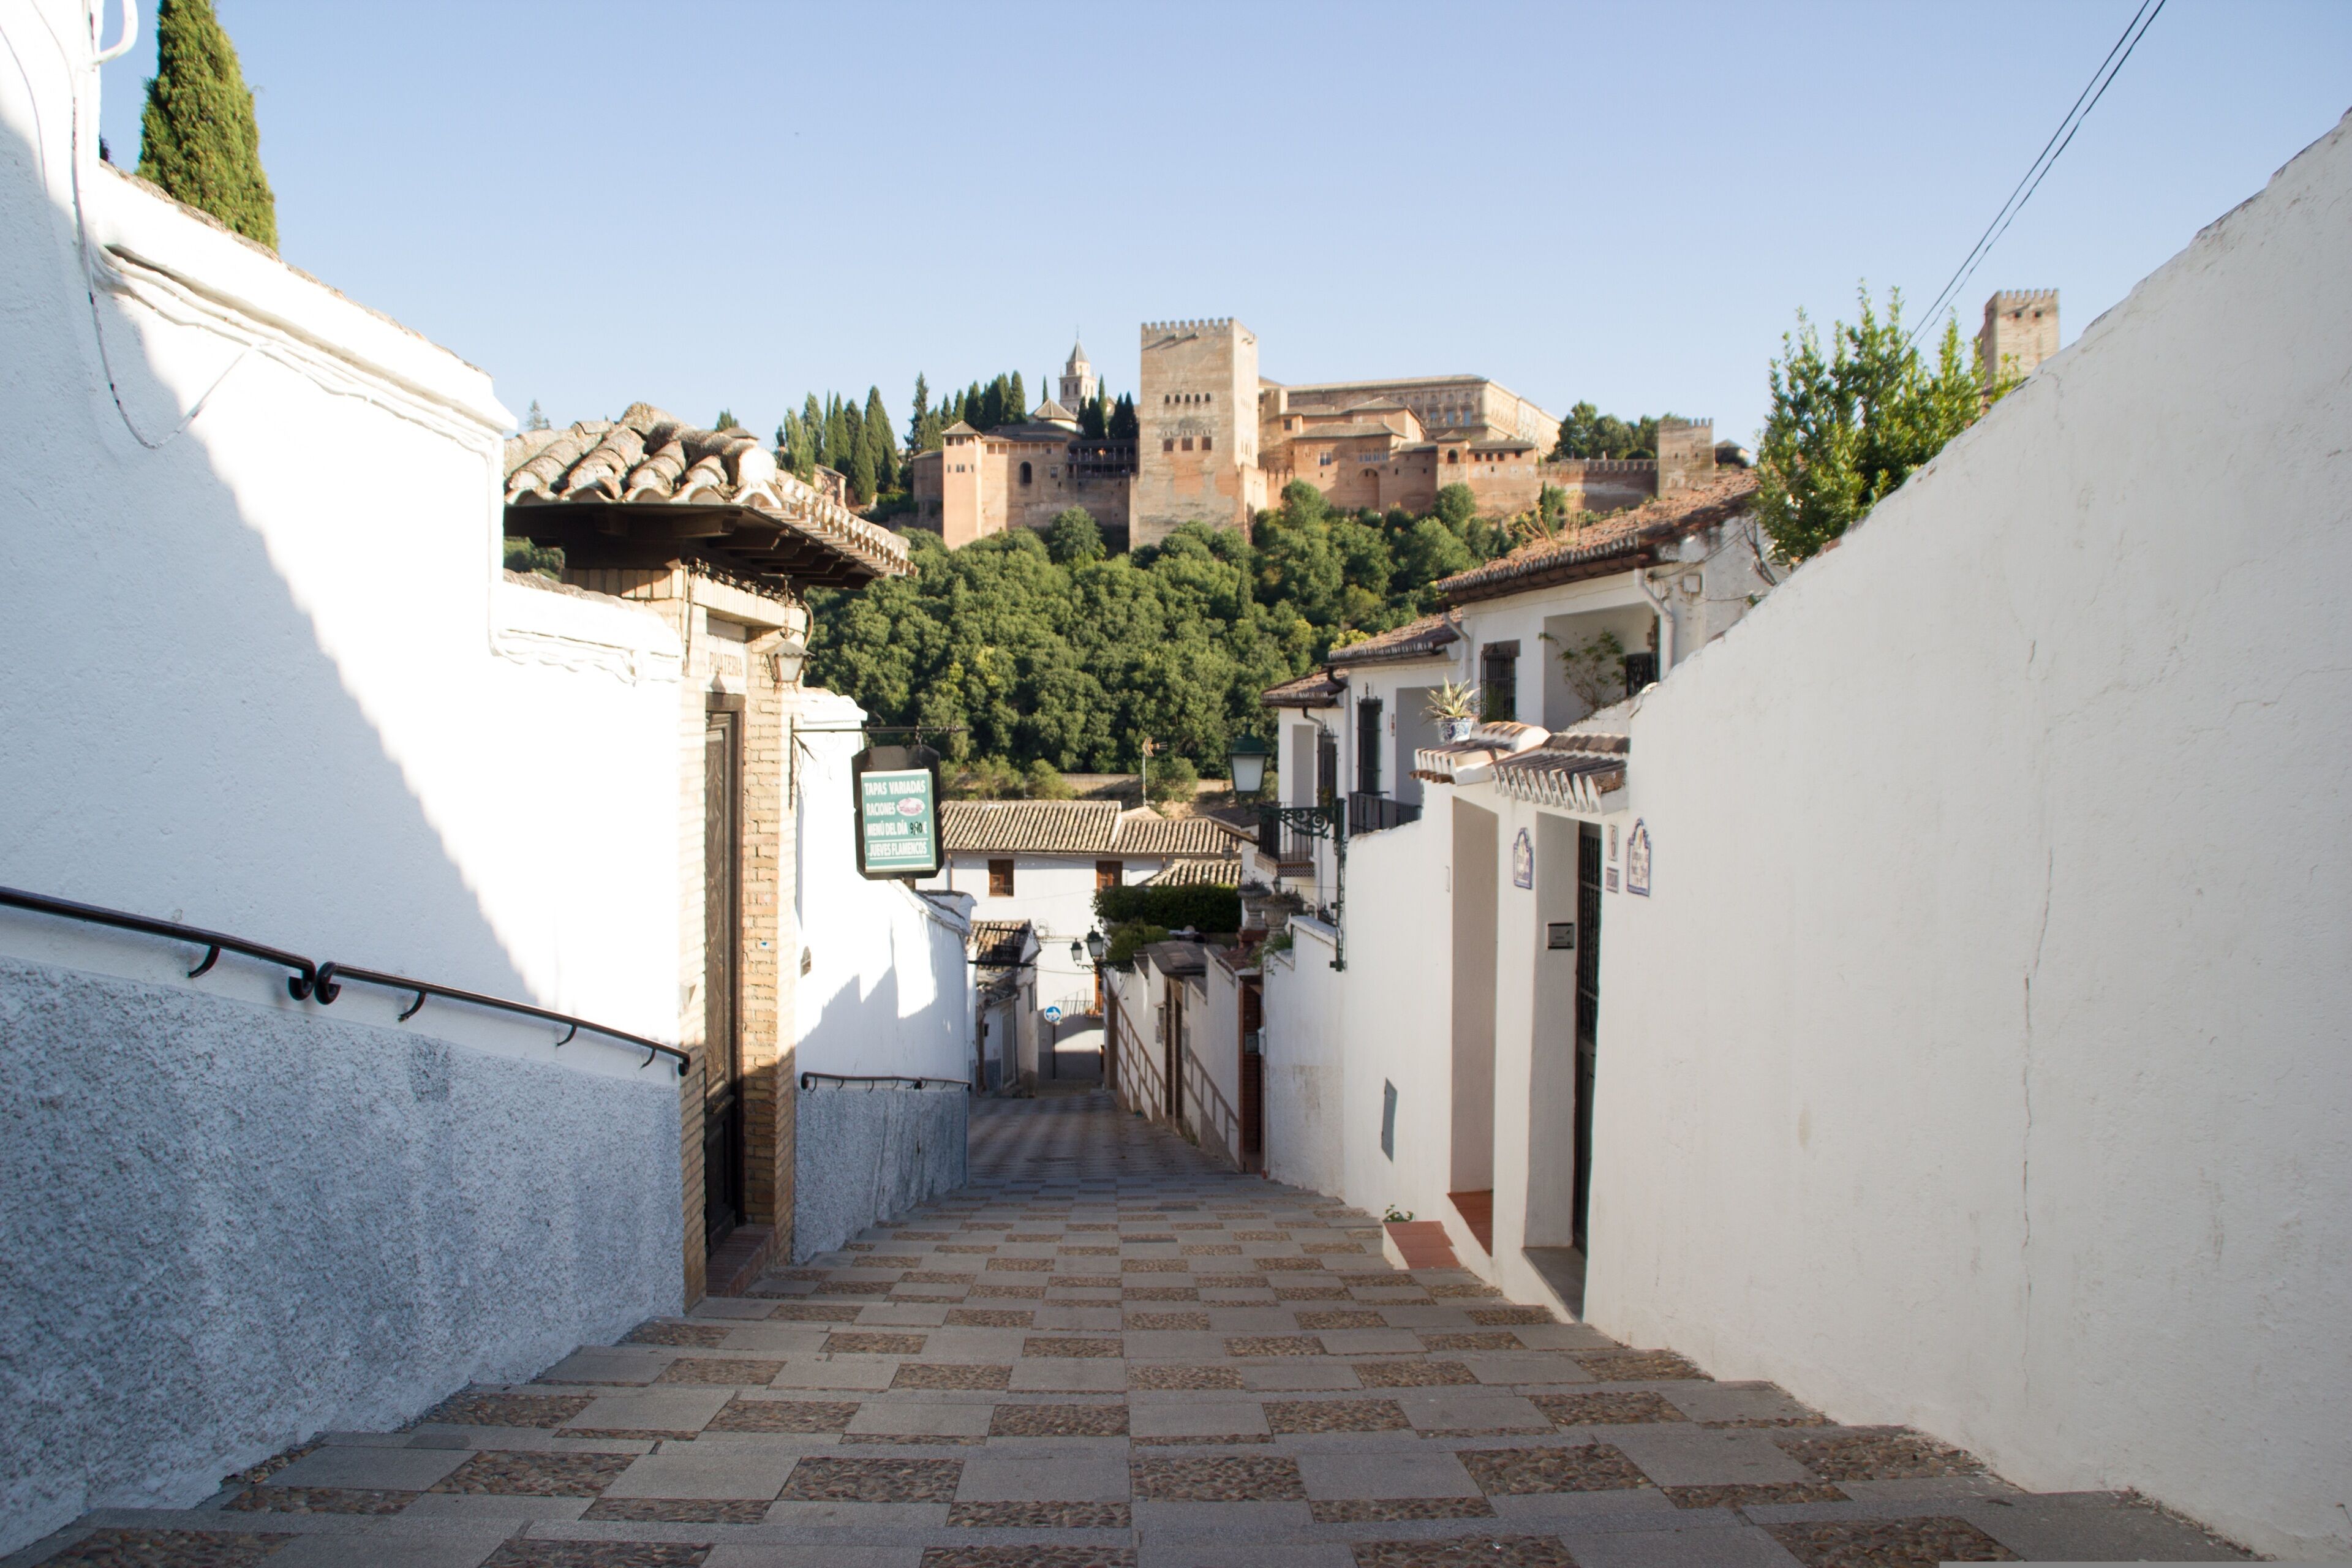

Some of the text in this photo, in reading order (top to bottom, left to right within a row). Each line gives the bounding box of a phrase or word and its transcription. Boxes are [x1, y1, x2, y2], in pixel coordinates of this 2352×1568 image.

[864, 780, 926, 796] TAPAS VARIADAS
[866, 802, 895, 816] RACIONES
[867, 820, 884, 837] MENÚ
[886, 822, 897, 835] DEL
[897, 819, 908, 835] DÍA
[869, 841, 927, 857] JUEVES FLAMENCOS
[1611, 829, 1616, 857] 6
